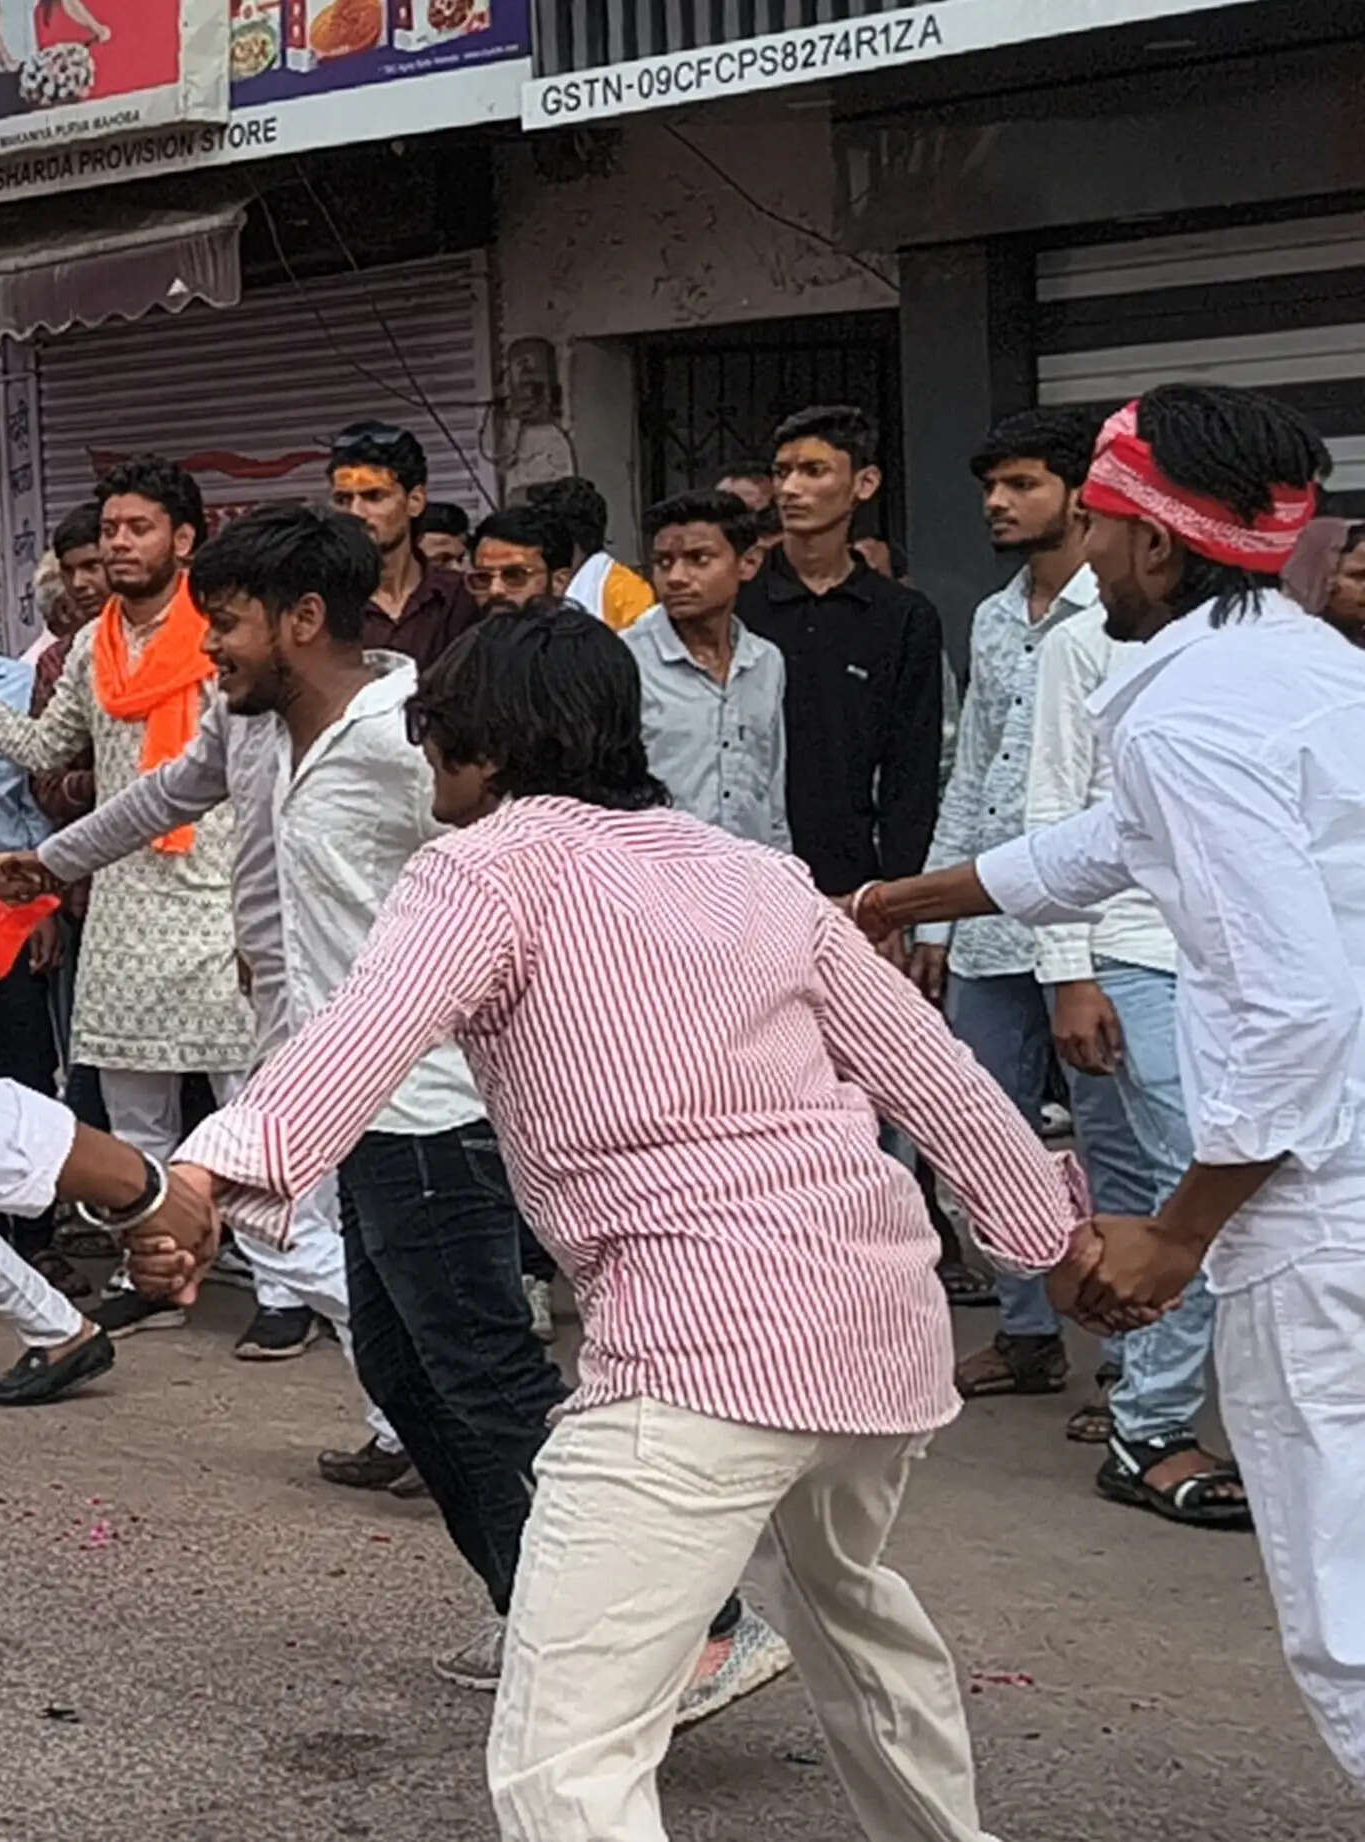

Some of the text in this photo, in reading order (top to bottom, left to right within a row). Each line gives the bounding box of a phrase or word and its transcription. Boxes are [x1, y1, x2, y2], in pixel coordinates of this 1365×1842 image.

[541, 14, 943, 116] GSTN-09CFCPS8274R1ZA
[76, 129, 196, 178] PROVISION
[200, 116, 277, 153] STORE
